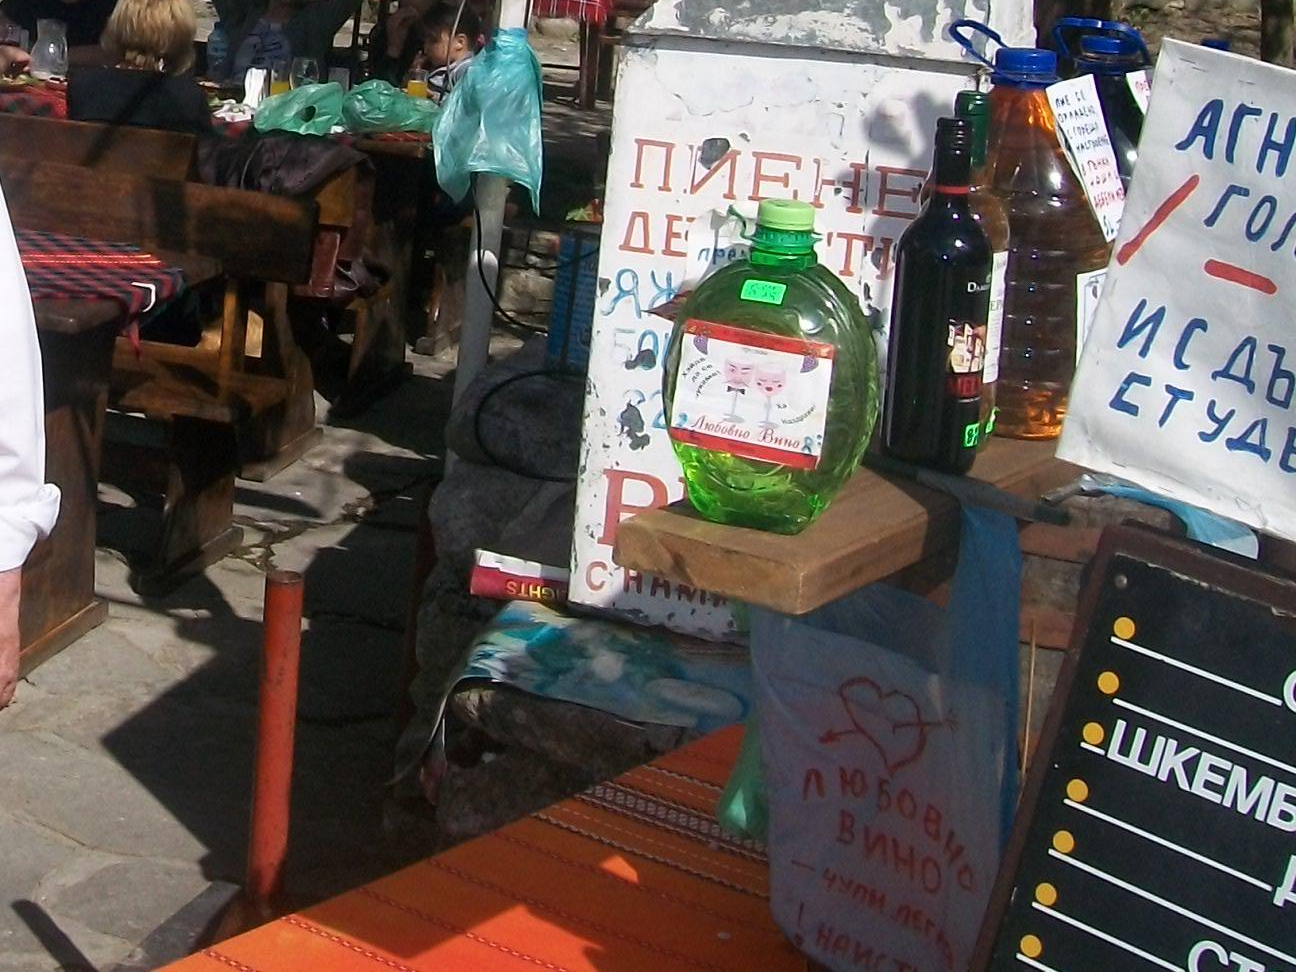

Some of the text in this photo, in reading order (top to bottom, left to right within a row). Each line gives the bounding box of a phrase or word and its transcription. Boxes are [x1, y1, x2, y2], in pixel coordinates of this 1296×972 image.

[630, 138, 929, 220] ПИЕНЕ
[691, 415, 751, 439] Любовно
[757, 428, 800, 449] Вино
[506, 581, 566, 600] IGHTS
[836, 809, 941, 894] ВИНО
